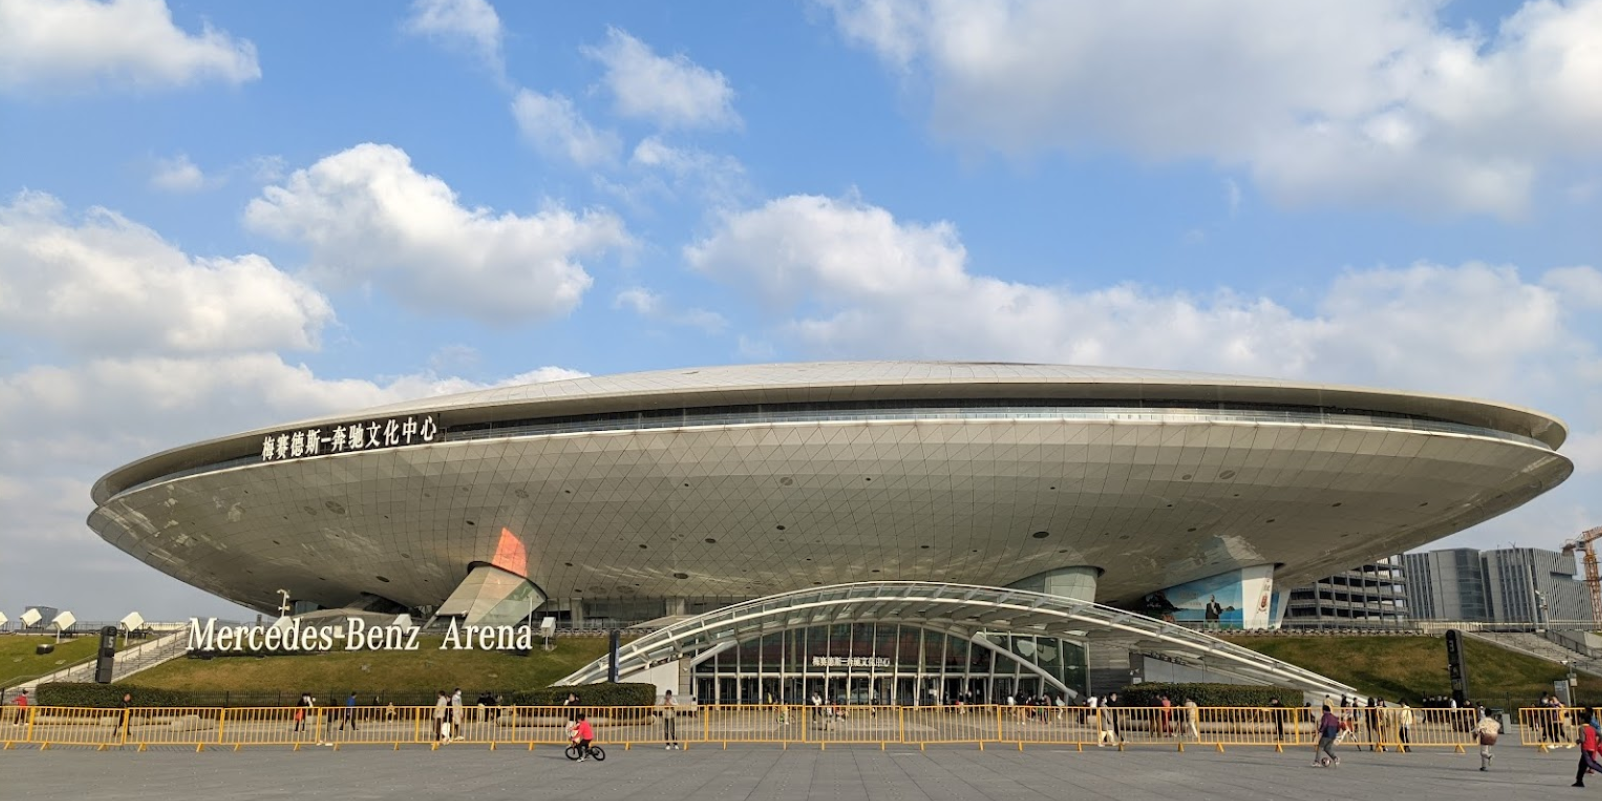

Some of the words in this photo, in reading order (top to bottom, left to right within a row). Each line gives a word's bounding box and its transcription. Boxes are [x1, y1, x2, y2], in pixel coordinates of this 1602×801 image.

[261, 415, 437, 461] 梅赛德斯-奔驰文化中心
[108, 636, 114, 648] 5
[185, 616, 421, 651] Mercedes-Benz
[439, 615, 533, 650] Arena
